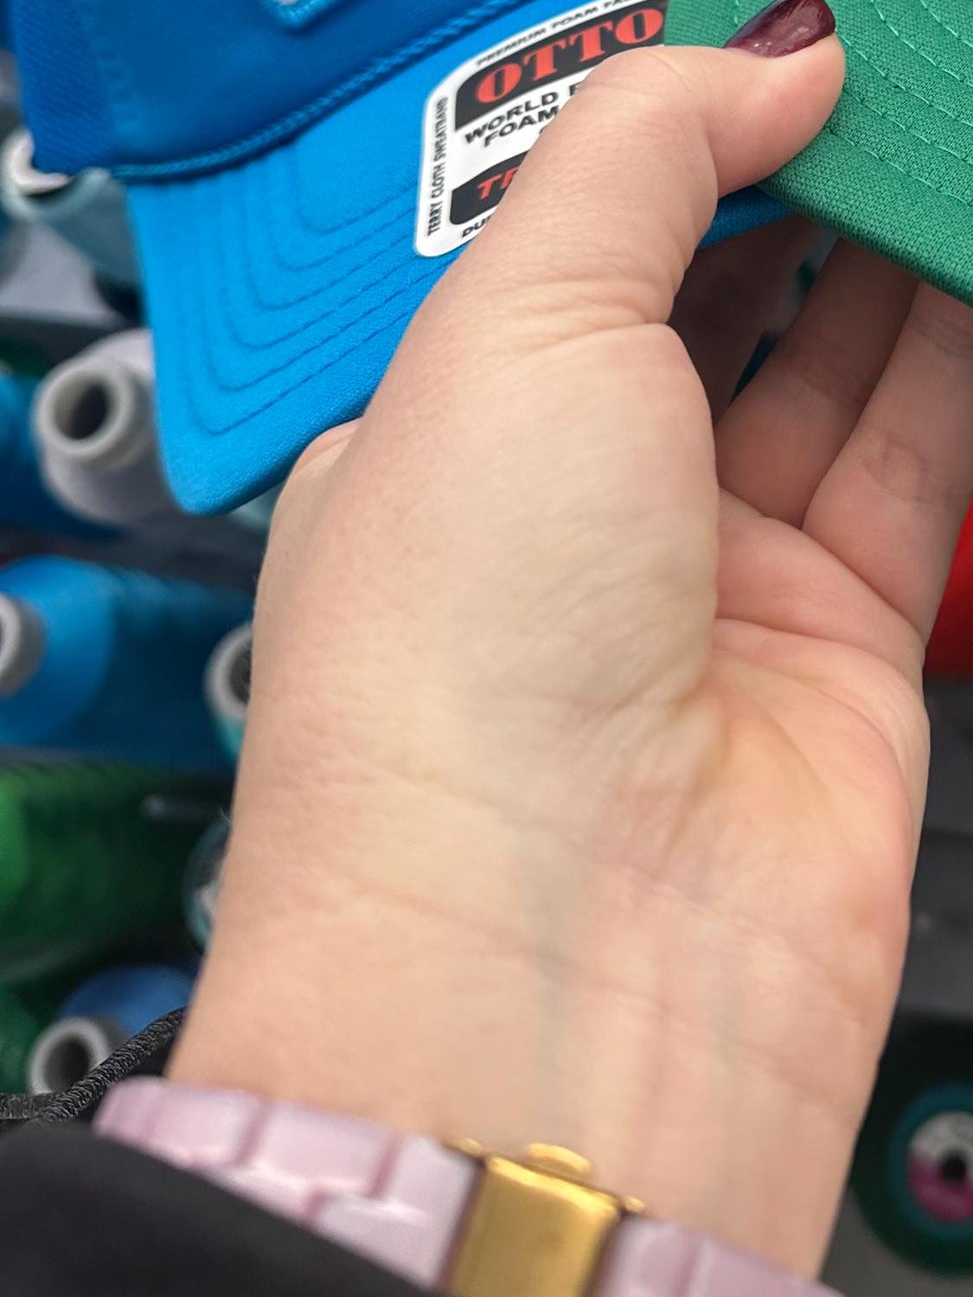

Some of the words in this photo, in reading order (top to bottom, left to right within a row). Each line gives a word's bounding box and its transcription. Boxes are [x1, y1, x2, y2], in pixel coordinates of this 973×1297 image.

[475, 8, 664, 104] OTTO
[477, 28, 547, 66] PREMIUM
[551, 6, 599, 30] FOAM
[465, 91, 560, 145] WORLD
[484, 105, 560, 148] FOAM
[431, 161, 447, 199] CLOTH
[427, 201, 443, 236] TERRY
